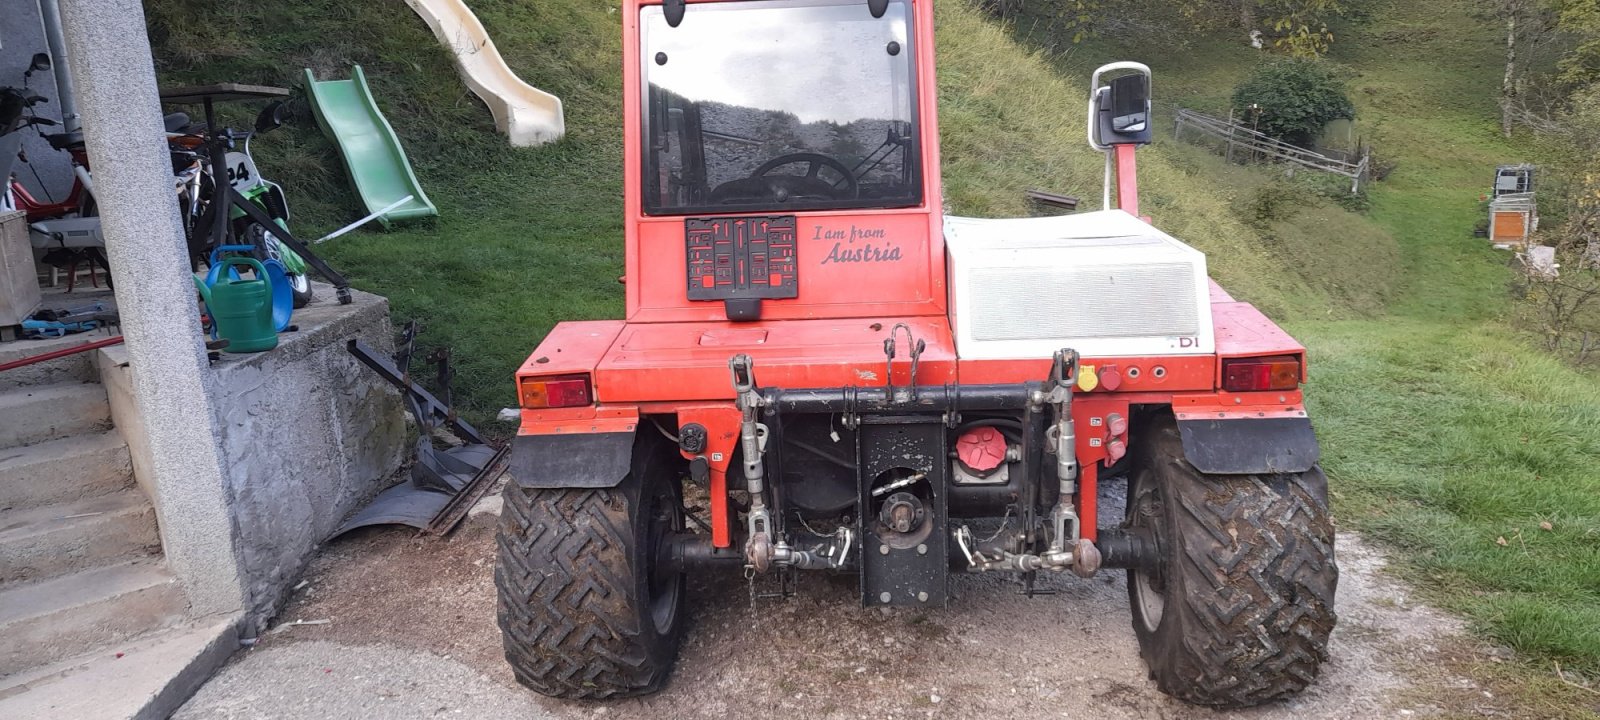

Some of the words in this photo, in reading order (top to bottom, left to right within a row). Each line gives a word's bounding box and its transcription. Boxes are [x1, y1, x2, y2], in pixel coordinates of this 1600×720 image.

[813, 226, 823, 240] I
[824, 230, 846, 239] am
[849, 225, 885, 243] from
[821, 242, 903, 264] Austria
